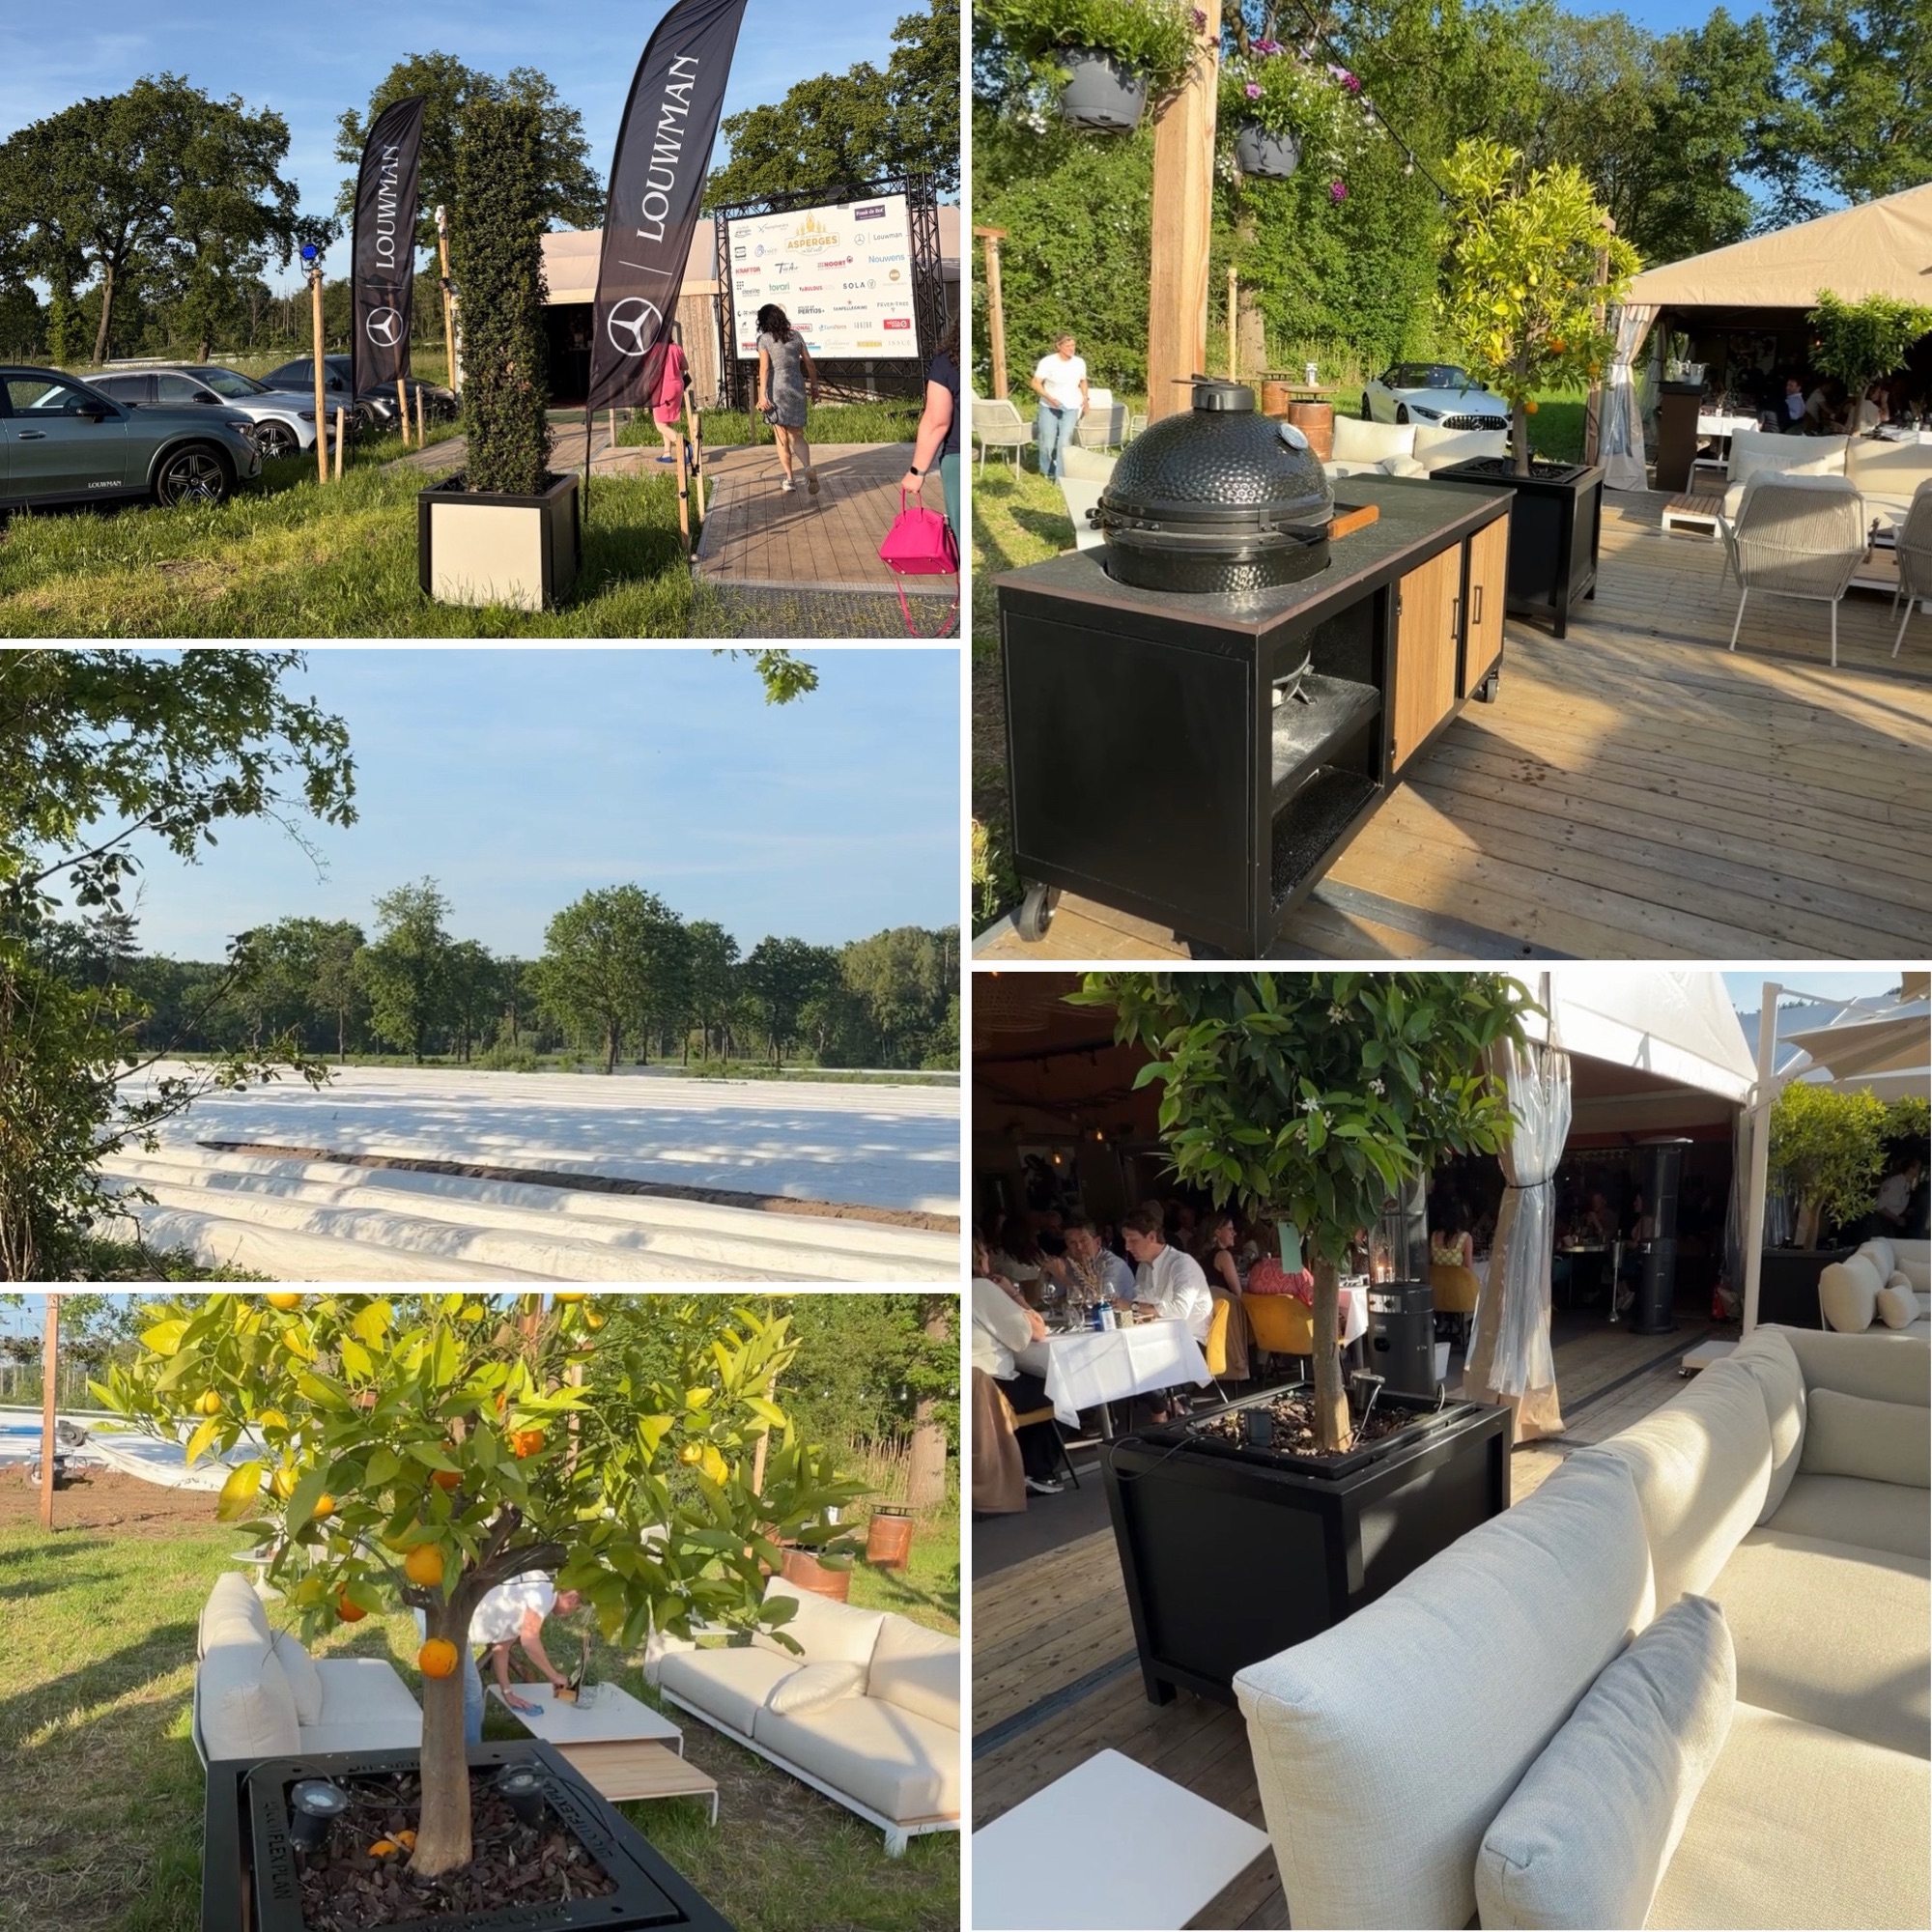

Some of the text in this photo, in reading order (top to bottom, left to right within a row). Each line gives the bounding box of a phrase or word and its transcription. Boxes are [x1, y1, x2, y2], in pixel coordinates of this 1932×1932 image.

[637, 52, 699, 243] LOUWMAN
[376, 145, 399, 270] LOUWMAN
[873, 232, 903, 241] Louwman
[787, 235, 838, 249] ASPERGES
[868, 254, 905, 263] Nouwens
[843, 281, 866, 290] SOLA
[88, 480, 122, 489] LOUWMAN
